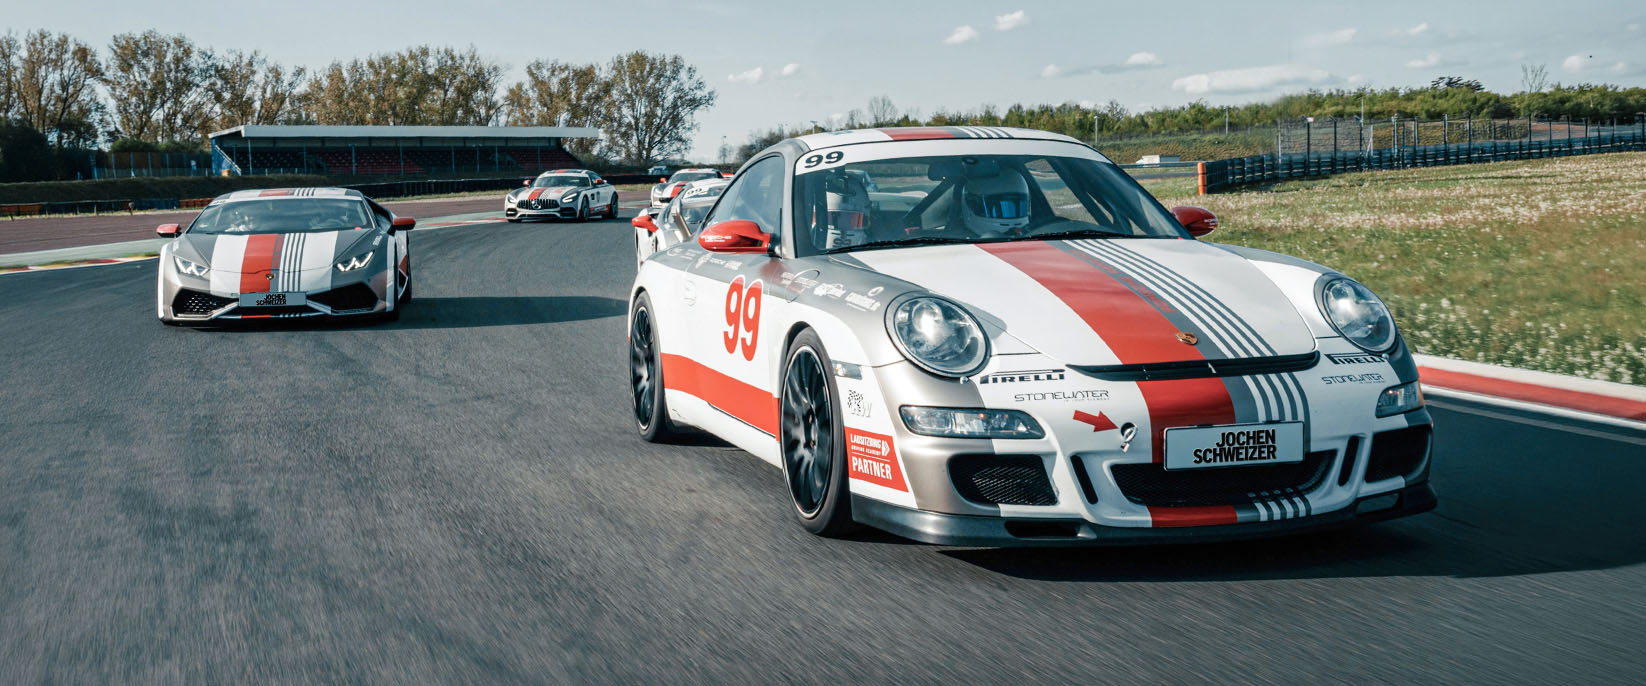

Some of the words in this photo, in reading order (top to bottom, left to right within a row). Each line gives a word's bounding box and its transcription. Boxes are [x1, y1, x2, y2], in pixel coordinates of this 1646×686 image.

[804, 151, 844, 168] 99
[723, 276, 763, 361] 99
[980, 369, 1065, 385] PIRELLI
[1014, 390, 1110, 402] STONEWATER
[1216, 429, 1276, 448] JOCHEN
[1193, 445, 1277, 464] SCHWEIZER
[851, 456, 893, 481] PARTNER
